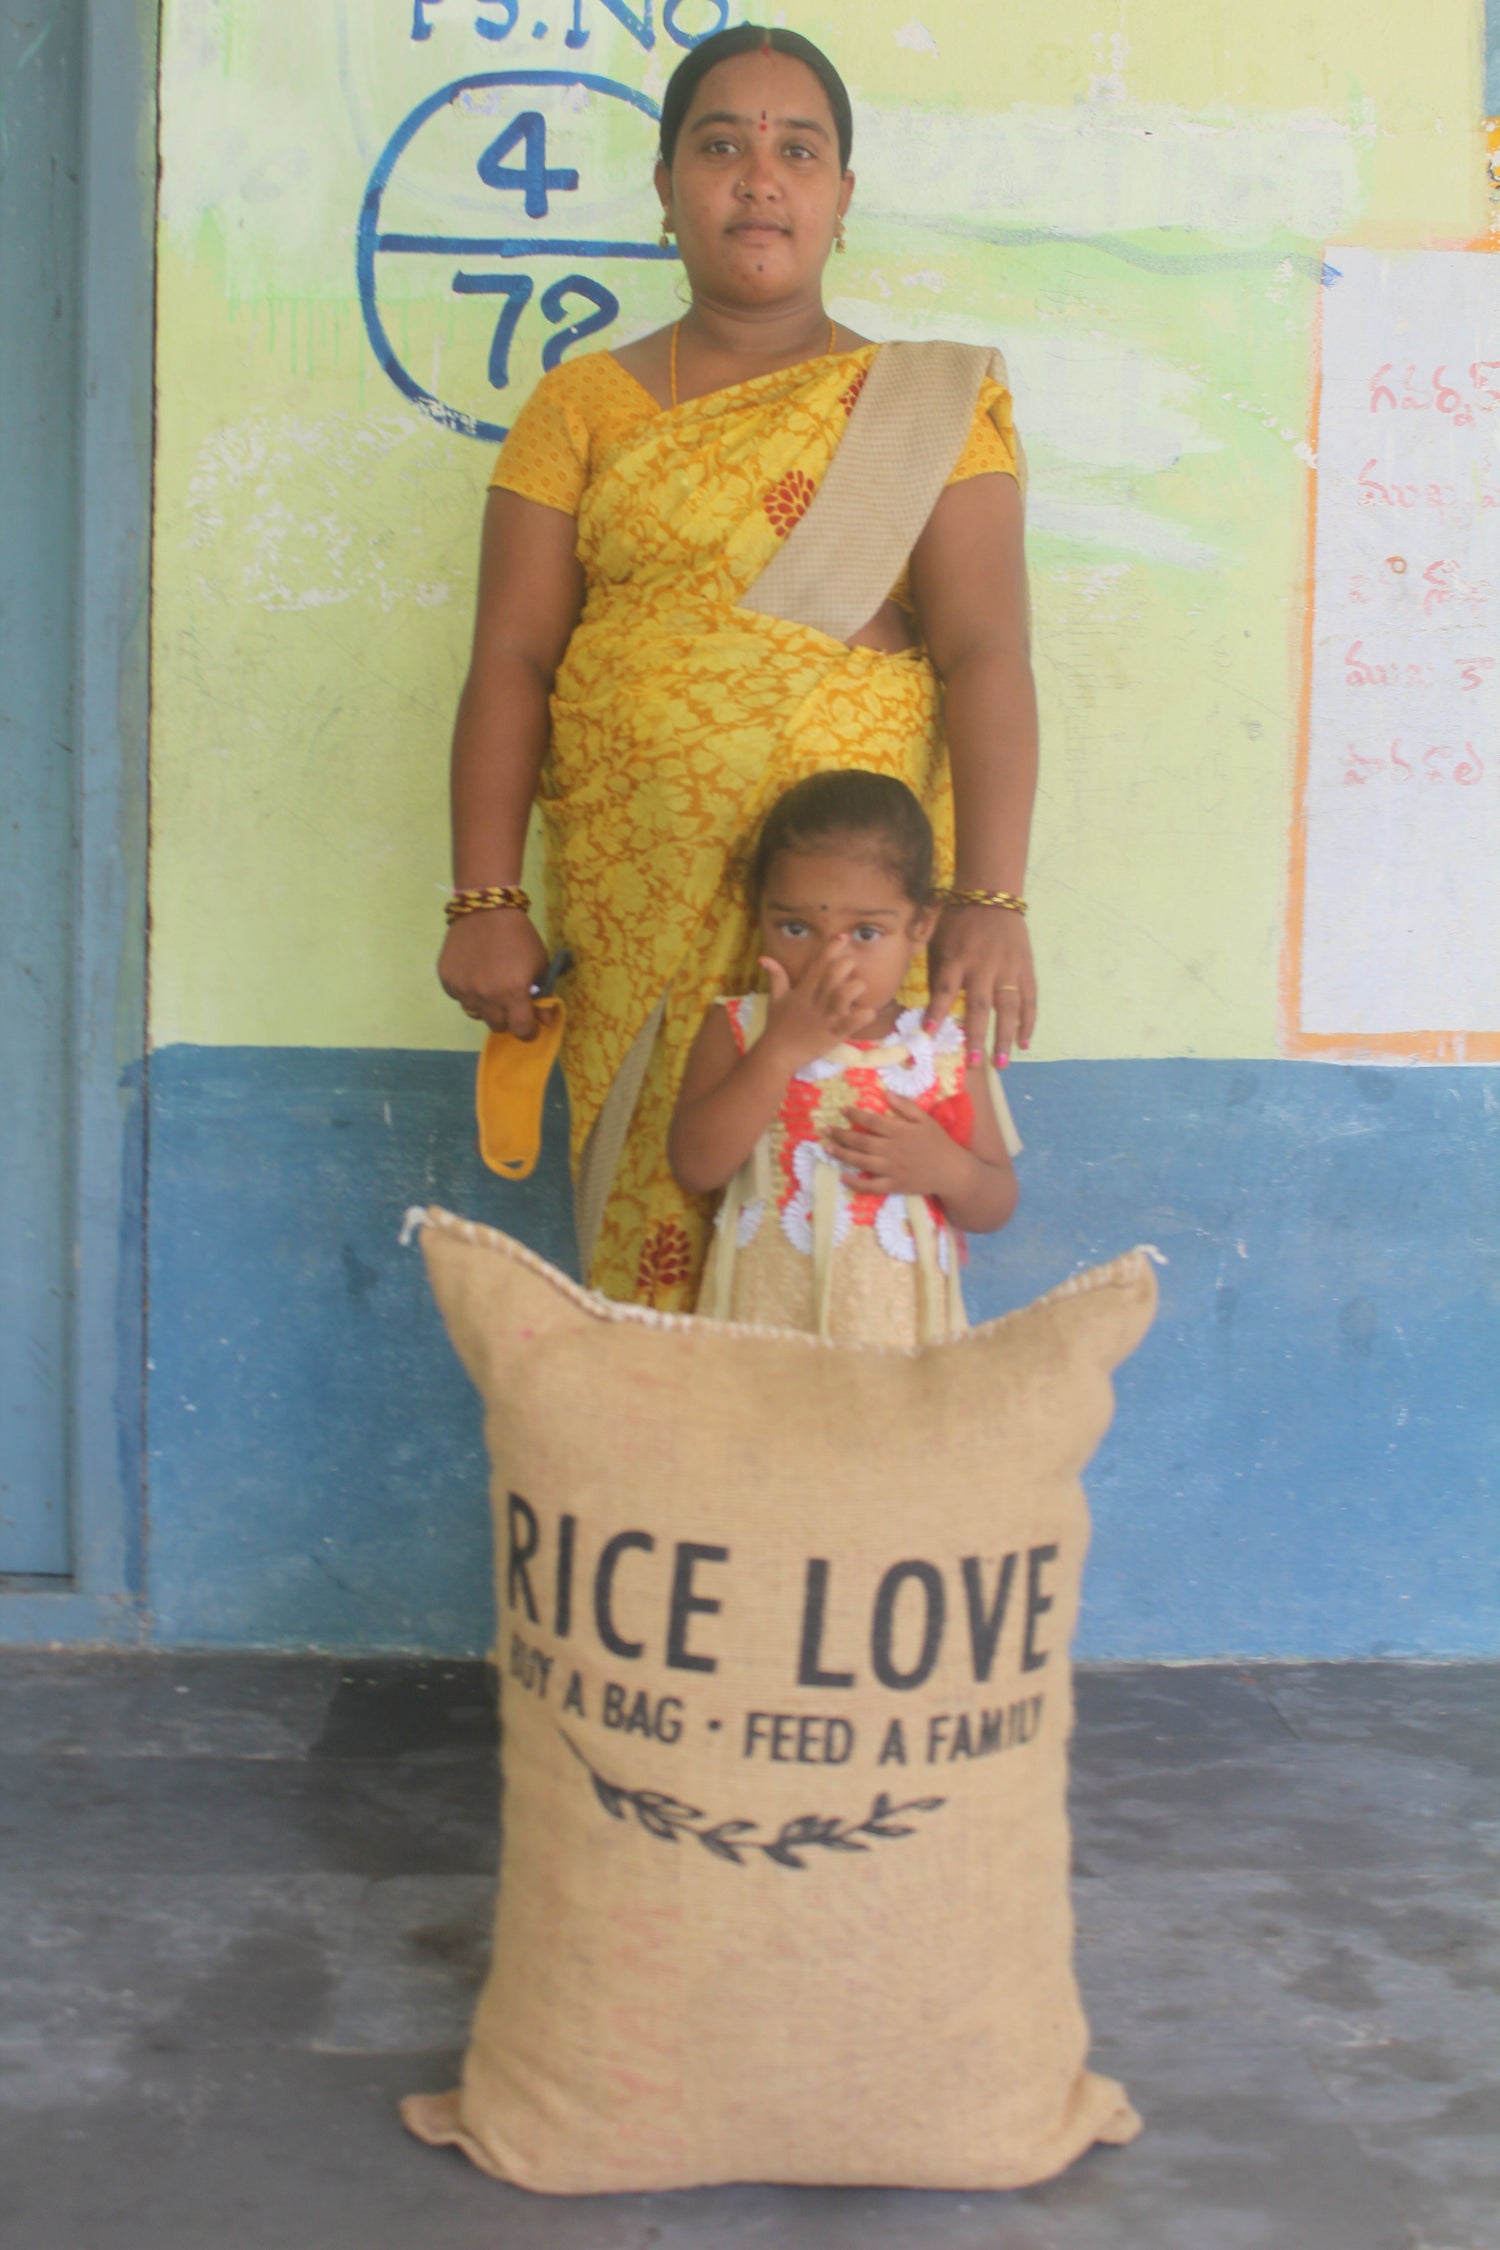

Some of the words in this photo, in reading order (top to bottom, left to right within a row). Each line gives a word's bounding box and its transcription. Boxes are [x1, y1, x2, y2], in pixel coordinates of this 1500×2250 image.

[477, 111, 580, 219] 4
[452, 271, 620, 390] 72
[507, 1490, 731, 1675] RICE
[797, 1542, 1060, 1692] LOVE
[562, 1668, 587, 1720] A
[602, 1681, 686, 1744] BAG
[742, 1712, 856, 1766] FEED
[877, 1717, 909, 1767] A
[926, 1690, 1045, 1765] FAMILY
